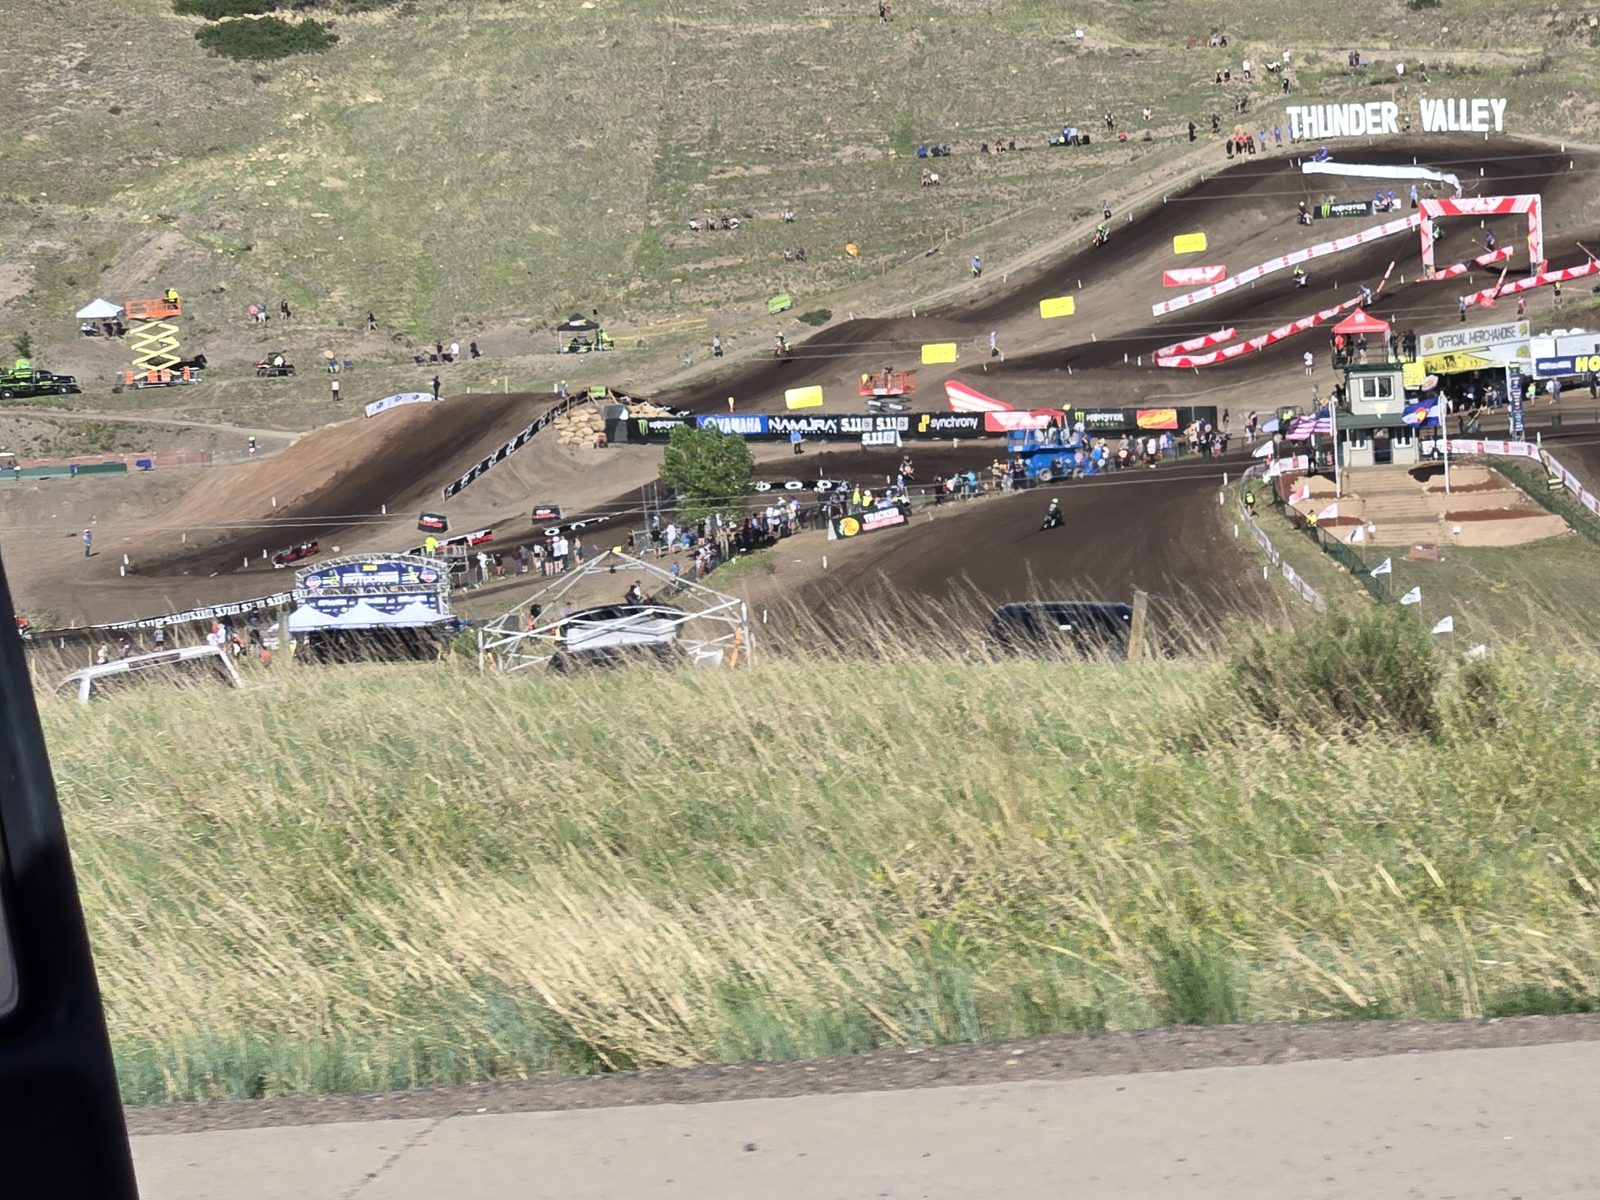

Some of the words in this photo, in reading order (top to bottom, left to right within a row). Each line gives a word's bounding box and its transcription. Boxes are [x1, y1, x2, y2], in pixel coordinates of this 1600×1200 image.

[1286, 101, 1399, 139] THUNDER
[1419, 98, 1507, 132] VALLEY
[1437, 332, 1467, 349] OFFICIAL
[1469, 325, 1517, 344] MERCHANDISE
[716, 417, 762, 434] YAMAHA
[768, 417, 838, 431] NAMURA
[930, 415, 979, 430] synchrony
